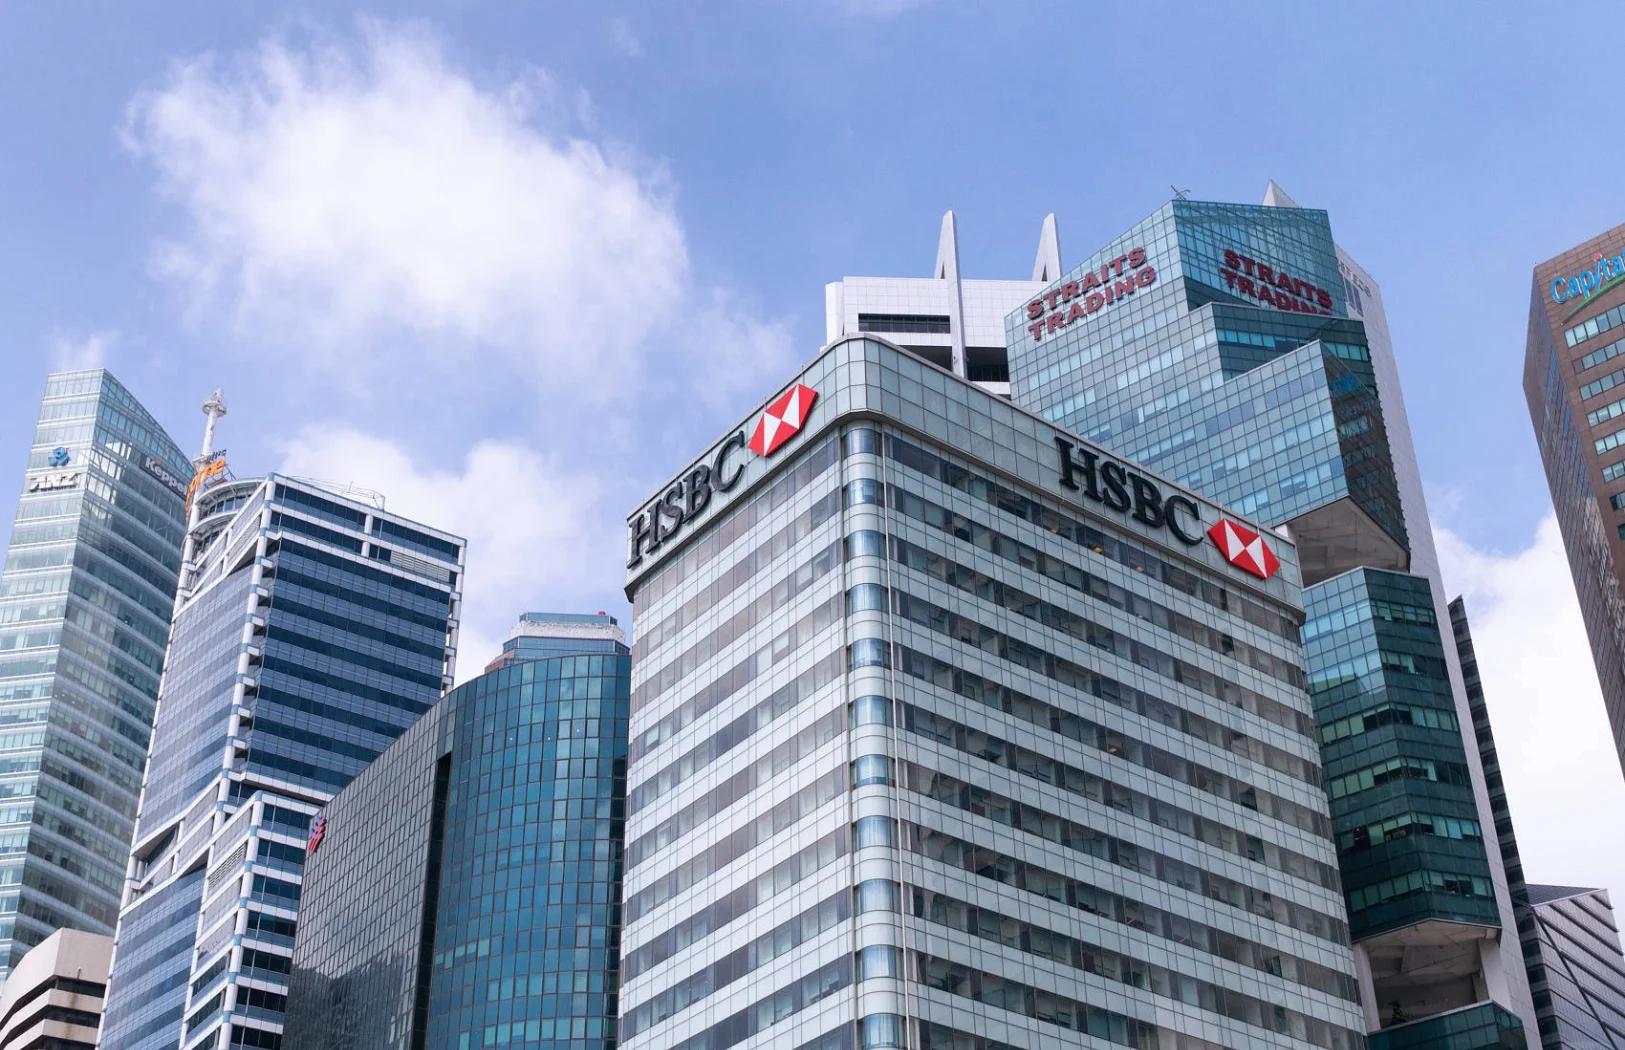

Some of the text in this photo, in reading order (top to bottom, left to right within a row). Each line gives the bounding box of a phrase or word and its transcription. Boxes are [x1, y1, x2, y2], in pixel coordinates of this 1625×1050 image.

[1027, 247, 1147, 320] STRAITS
[1028, 266, 1156, 342] TRADING
[1220, 267, 1334, 315] TRADIN
[1223, 248, 1333, 309] STRAITS
[29, 472, 82, 492] ANZ
[627, 430, 745, 569] HSBC
[1054, 436, 1204, 546] HSBC
